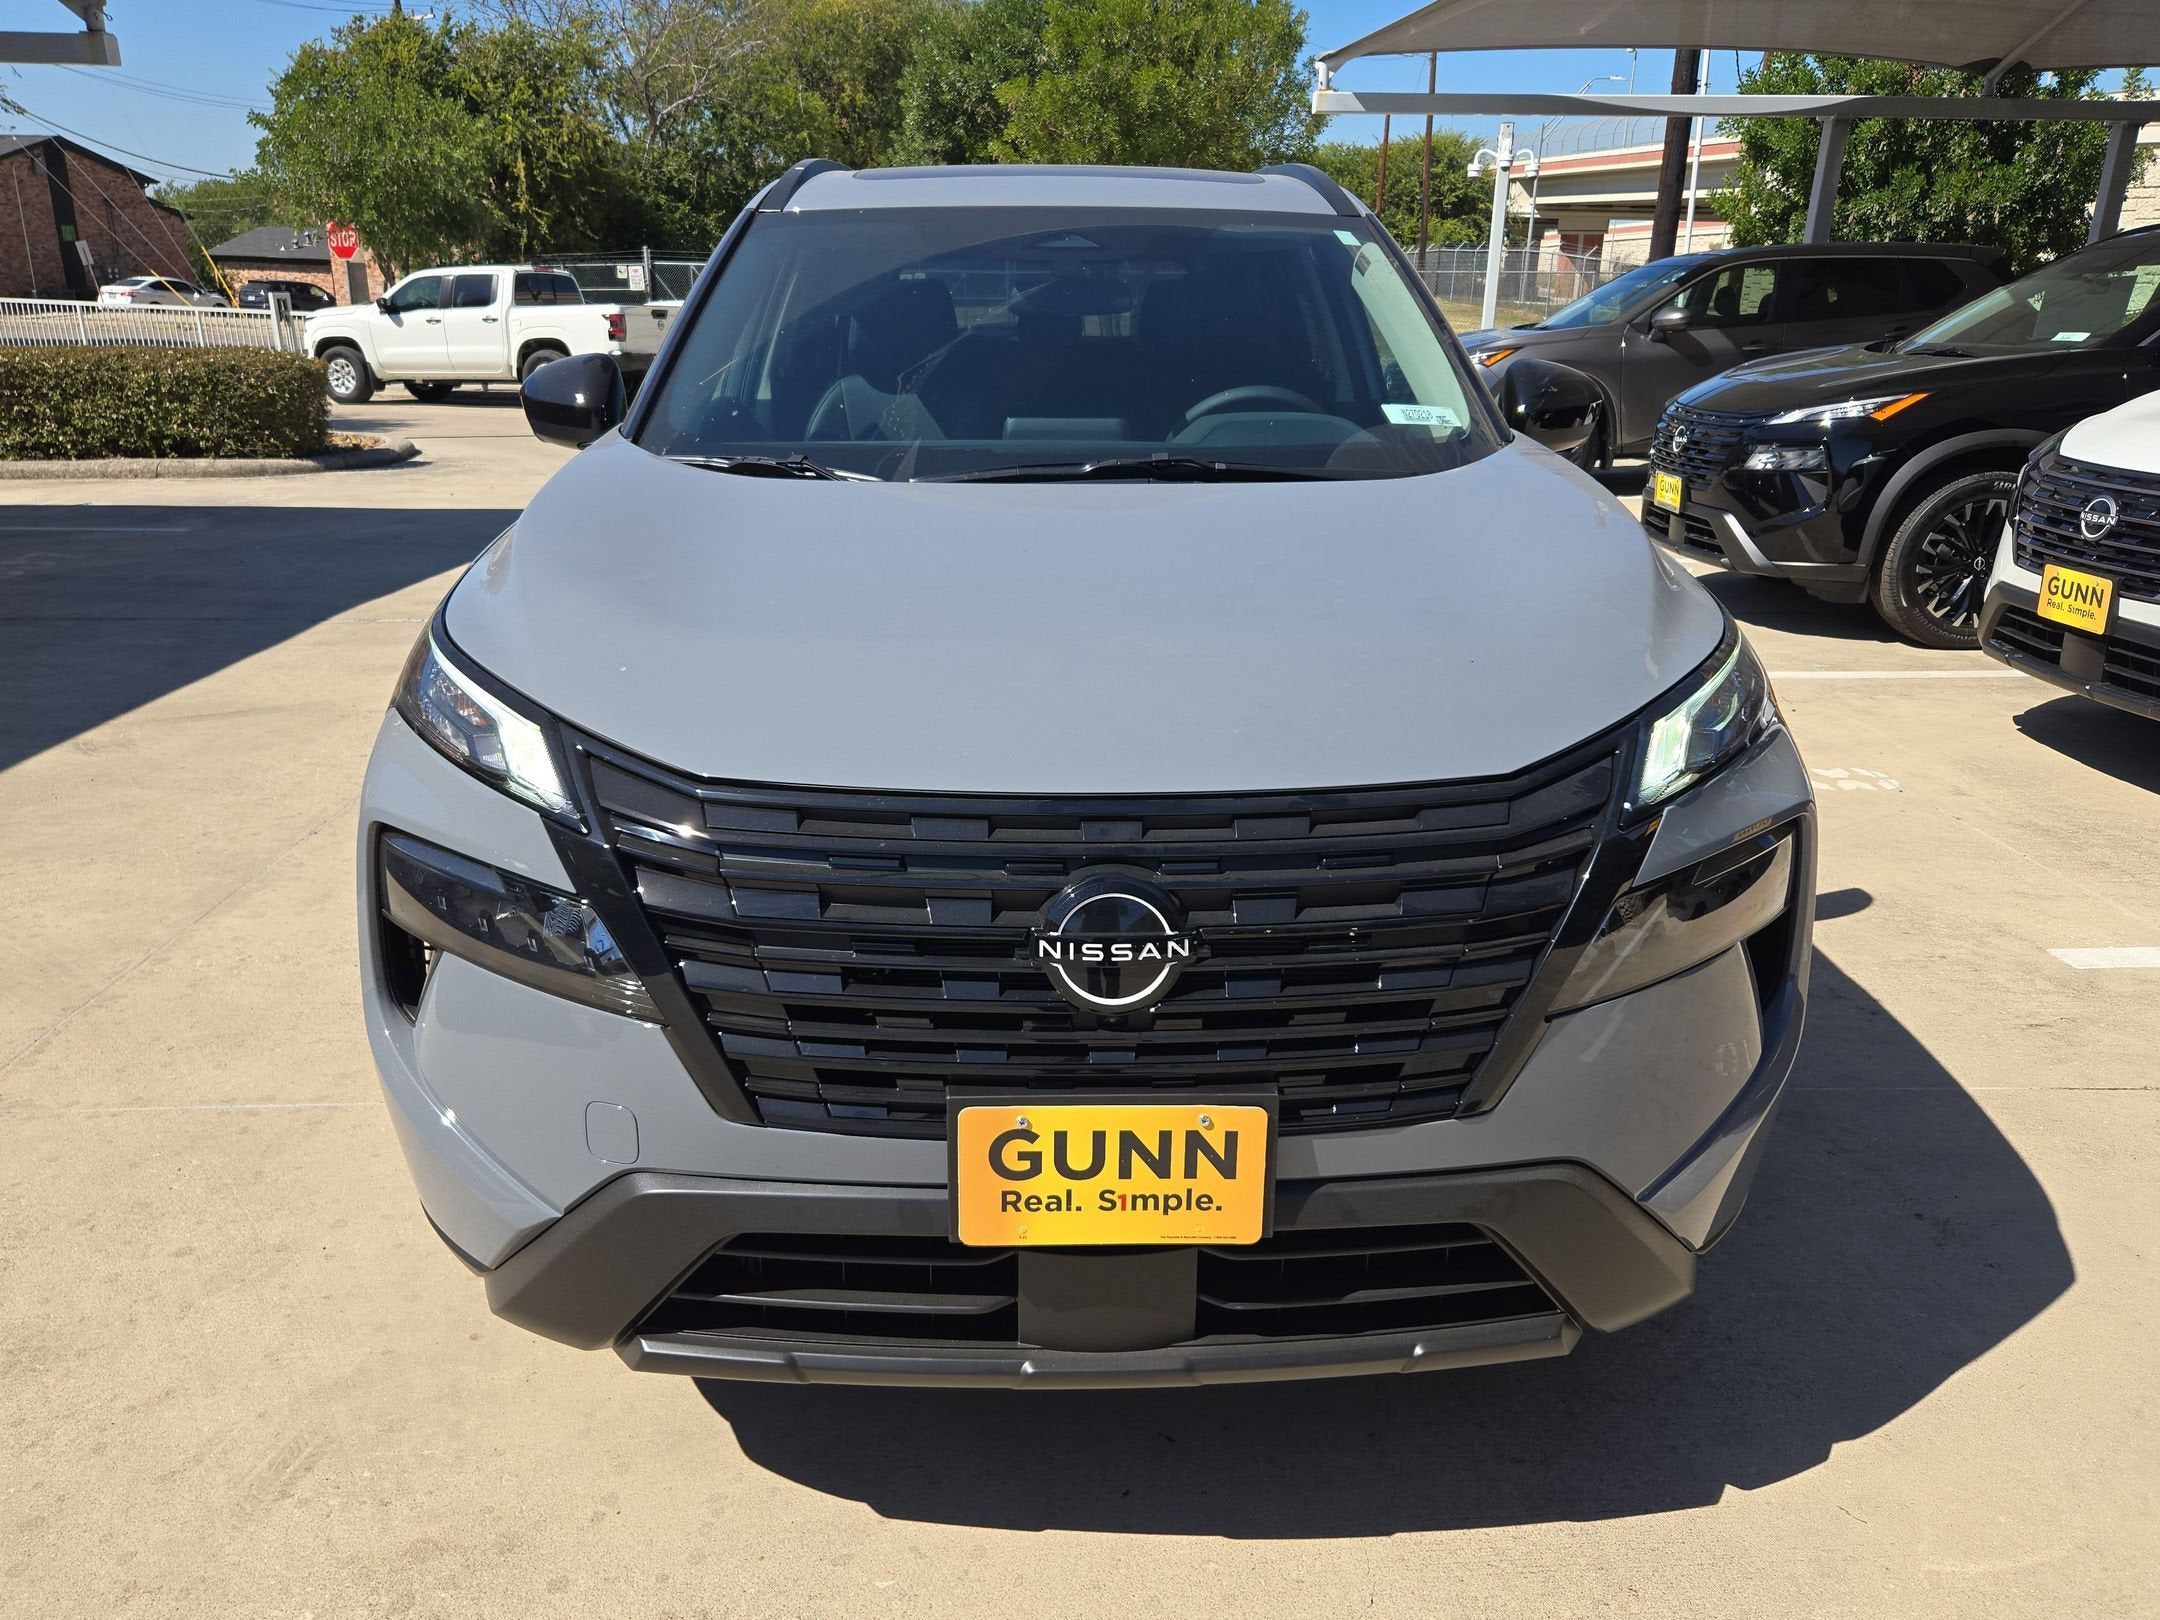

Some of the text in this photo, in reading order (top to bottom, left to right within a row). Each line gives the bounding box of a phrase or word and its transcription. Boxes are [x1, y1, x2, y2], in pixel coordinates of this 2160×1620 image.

[330, 230, 356, 247] STOP
[1660, 479, 1679, 495] GUNN
[2080, 511, 2116, 525] NISSAN
[2047, 576, 2105, 609] GUNN
[2046, 598, 2065, 611] Real.
[1038, 938, 1190, 962] NISSAN
[988, 1128, 1239, 1181] GUNN
[1001, 1188, 1082, 1213] Real.
